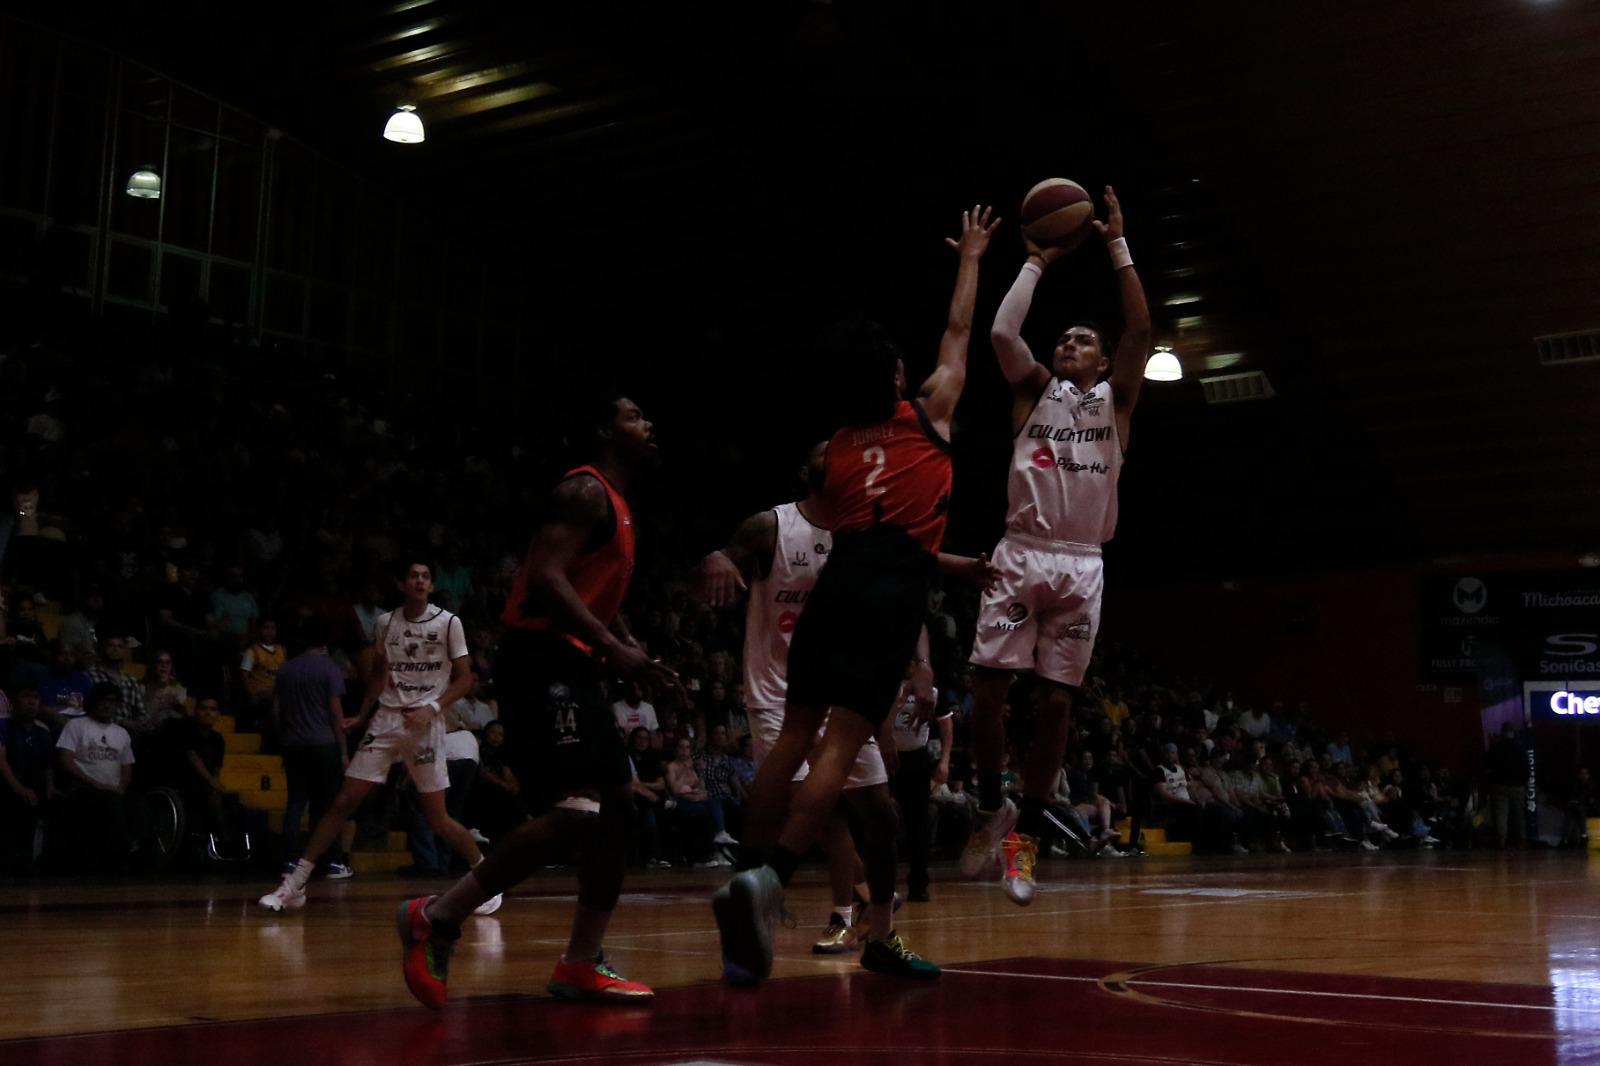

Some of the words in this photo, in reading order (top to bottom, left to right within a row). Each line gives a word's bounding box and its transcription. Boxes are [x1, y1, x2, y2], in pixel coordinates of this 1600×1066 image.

[863, 446, 887, 496] 2
[1057, 457, 1088, 473] Pizza
[1090, 462, 1112, 475] Hut
